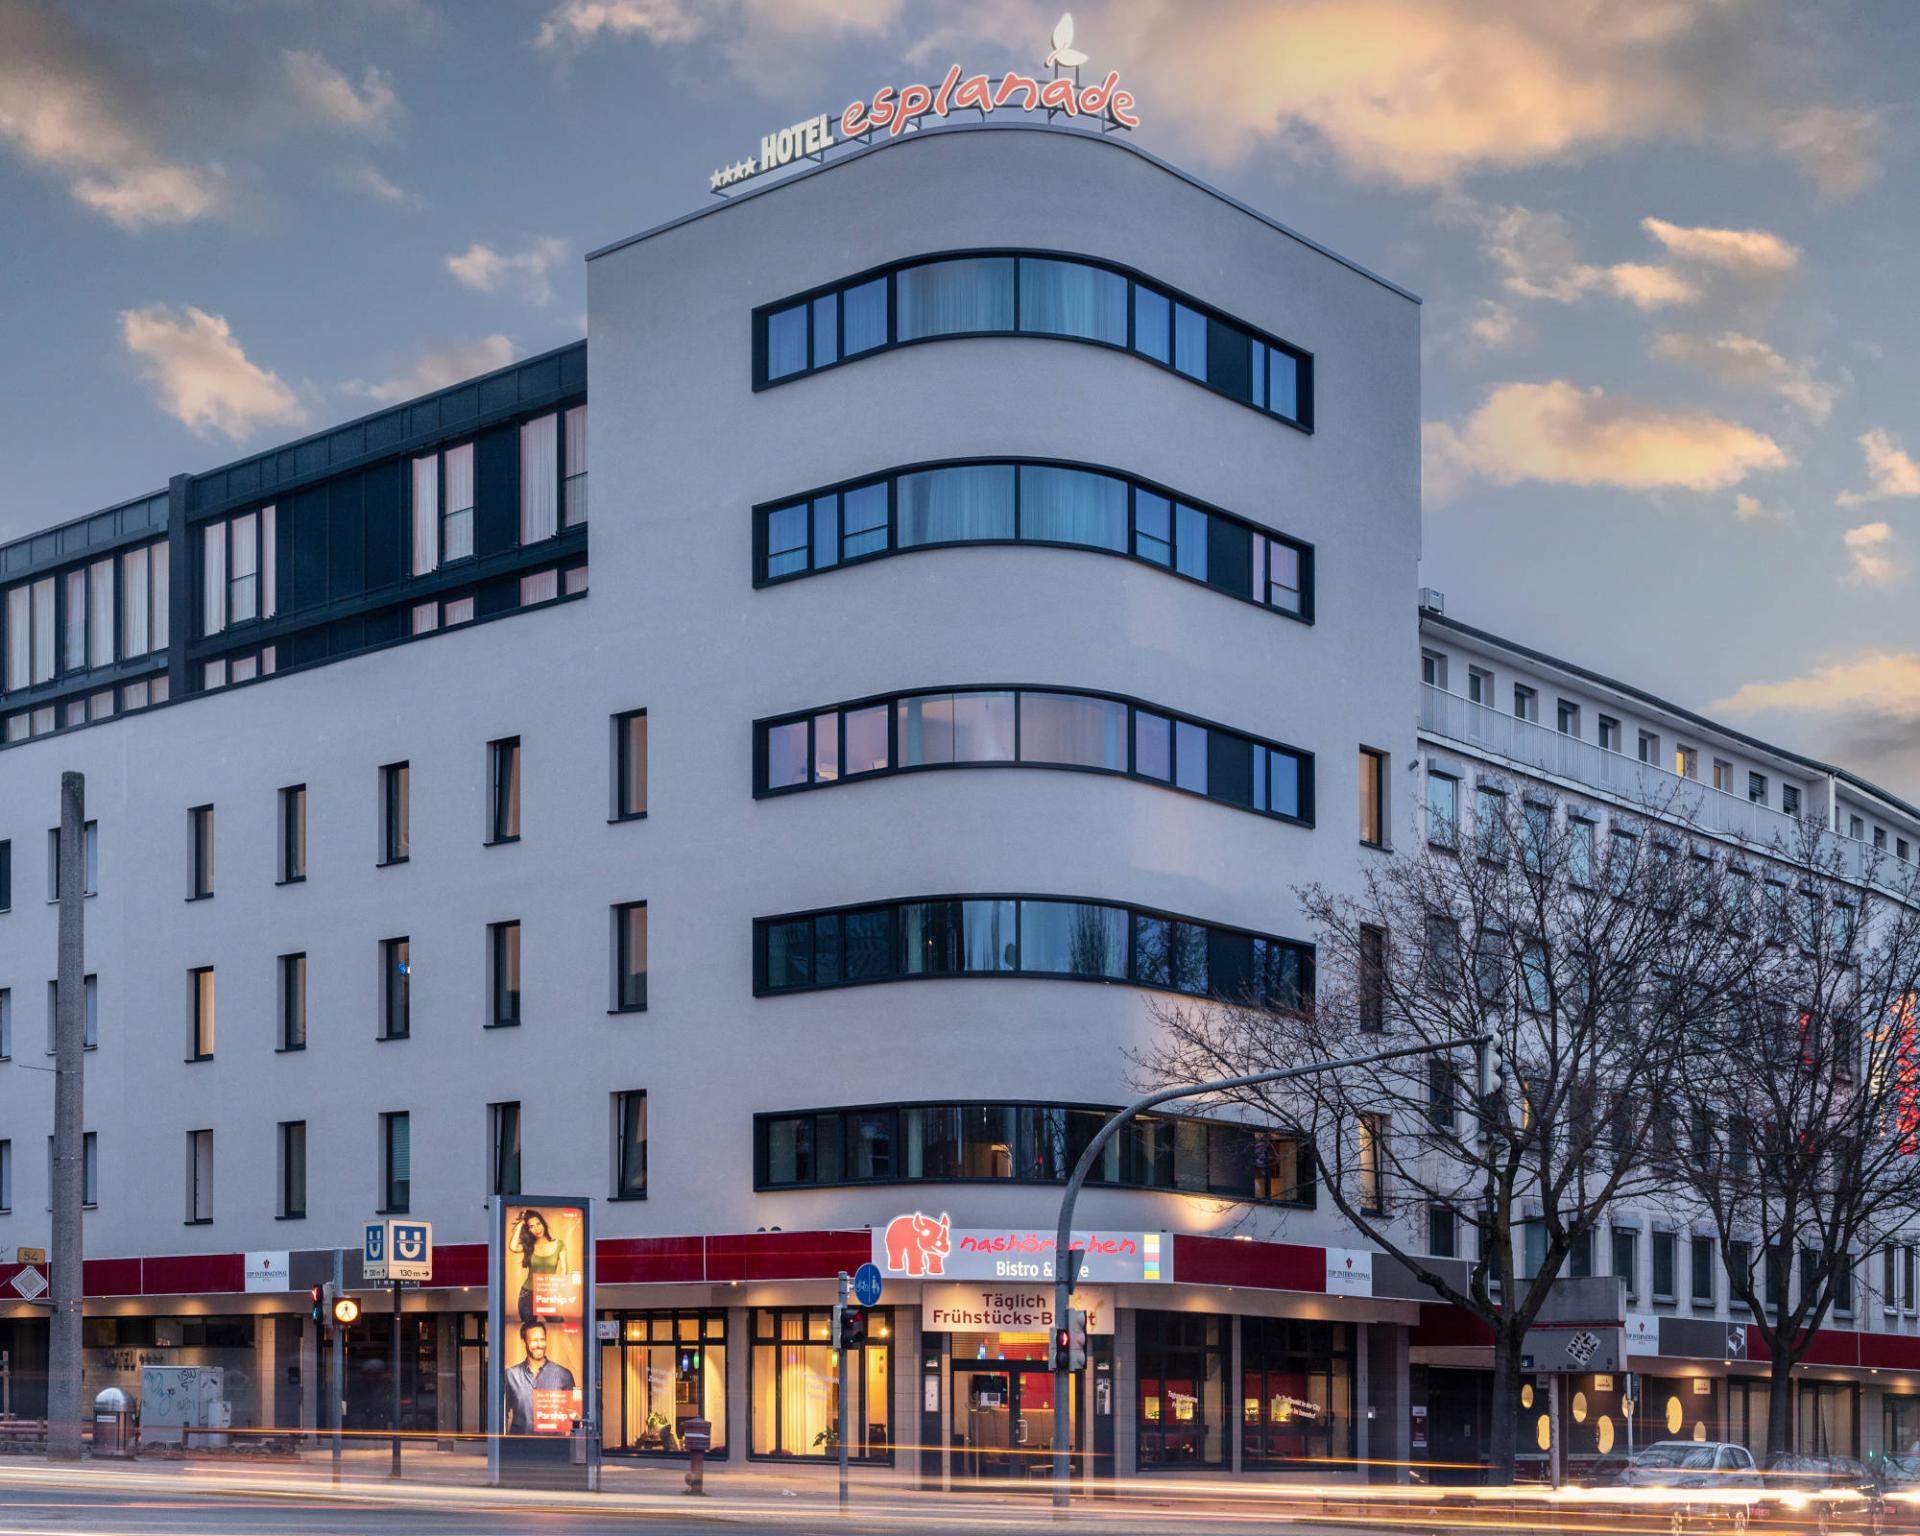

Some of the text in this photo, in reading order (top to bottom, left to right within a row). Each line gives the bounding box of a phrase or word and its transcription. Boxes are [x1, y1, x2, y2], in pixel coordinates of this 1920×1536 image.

[761, 64, 1139, 171] HOTEL esplanade
[399, 1231, 420, 1258] U
[400, 1269, 412, 1277] 130
[996, 1261, 1053, 1277] Bistro &
[982, 1293, 1046, 1310] Täglich
[933, 1309, 1096, 1326] Frühstücks-Bt
